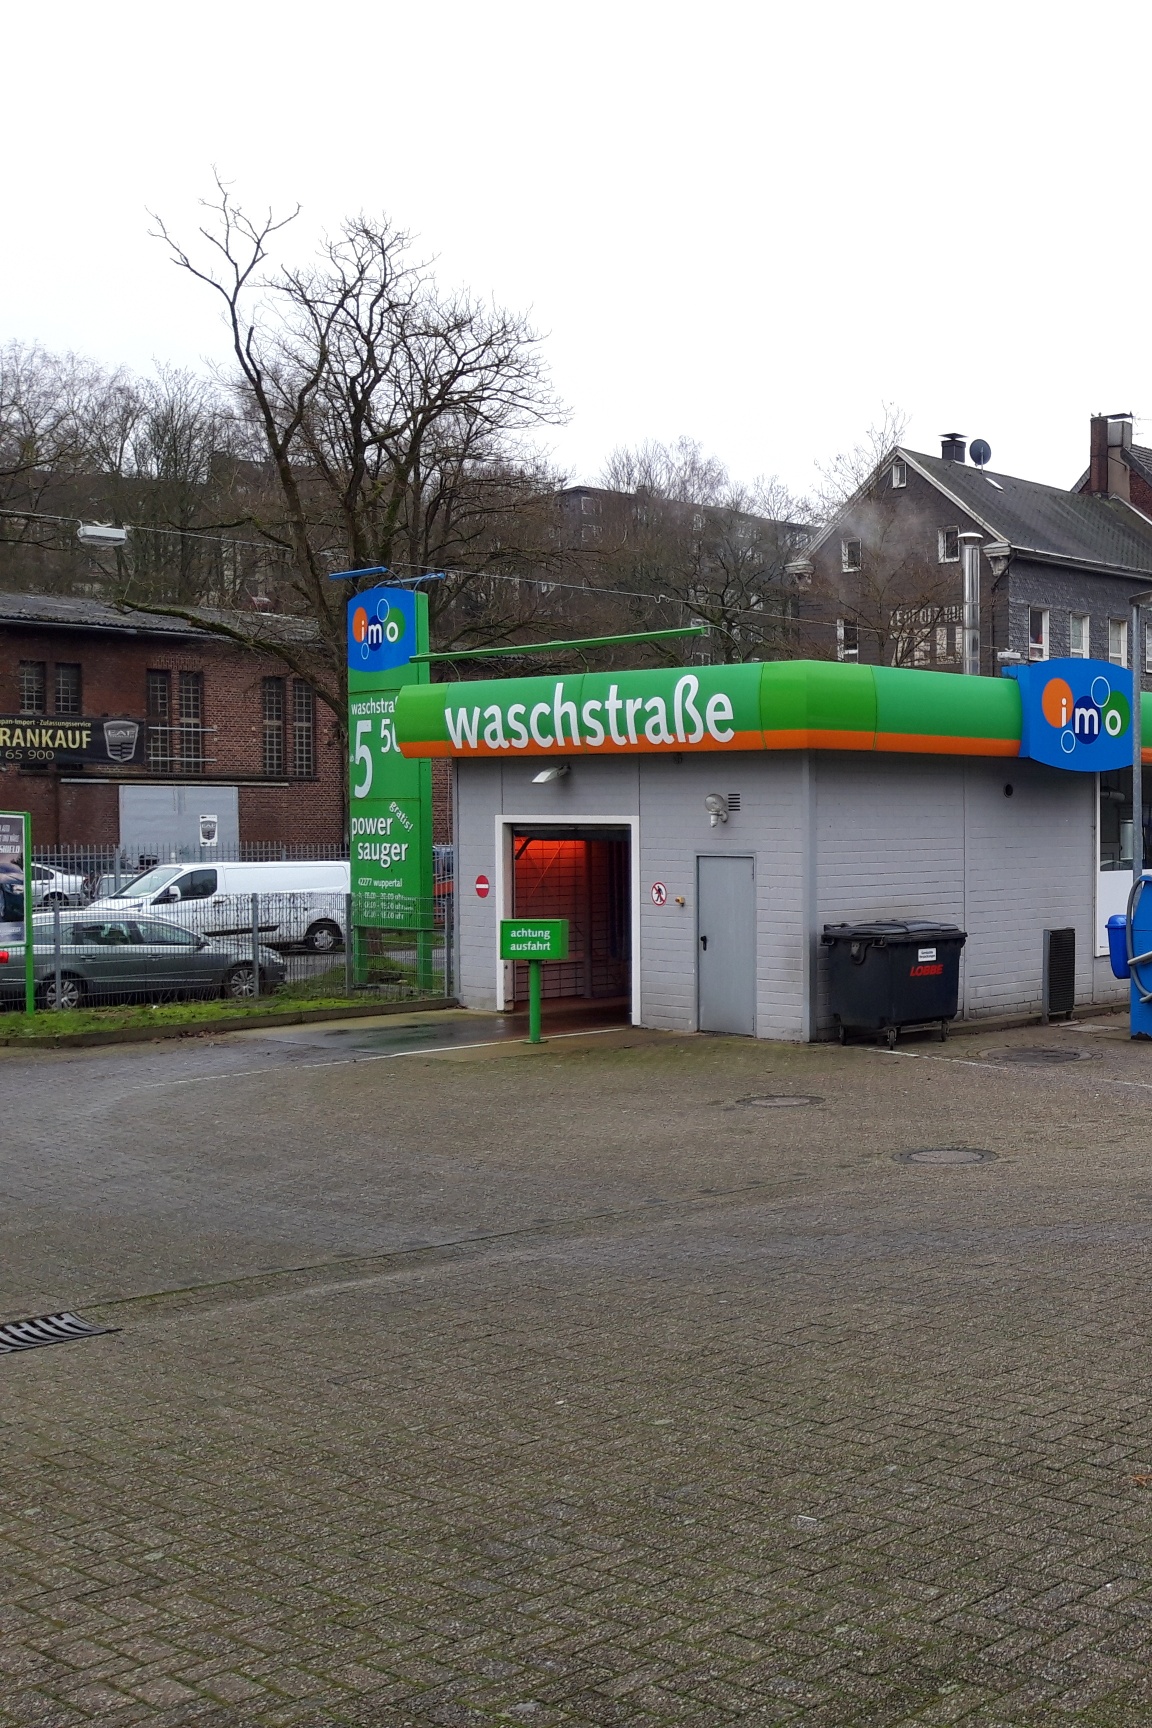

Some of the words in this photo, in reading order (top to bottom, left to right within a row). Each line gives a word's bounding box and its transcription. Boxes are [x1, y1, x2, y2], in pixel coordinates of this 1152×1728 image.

[361, 620, 399, 644] imo
[444, 674, 735, 749] waschstraße
[1061, 697, 1122, 736] imo
[0, 727, 92, 749] RANKAUF
[5, 749, 23, 760] 65
[28, 750, 55, 760] 900
[389, 801, 414, 832] gratis!
[351, 817, 393, 841] power
[357, 842, 408, 868] sauger
[373, 877, 403, 889] wuppertal
[510, 928, 551, 940] achtung
[510, 941, 551, 951] ausfahrt
[910, 964, 944, 977] LOBBE
